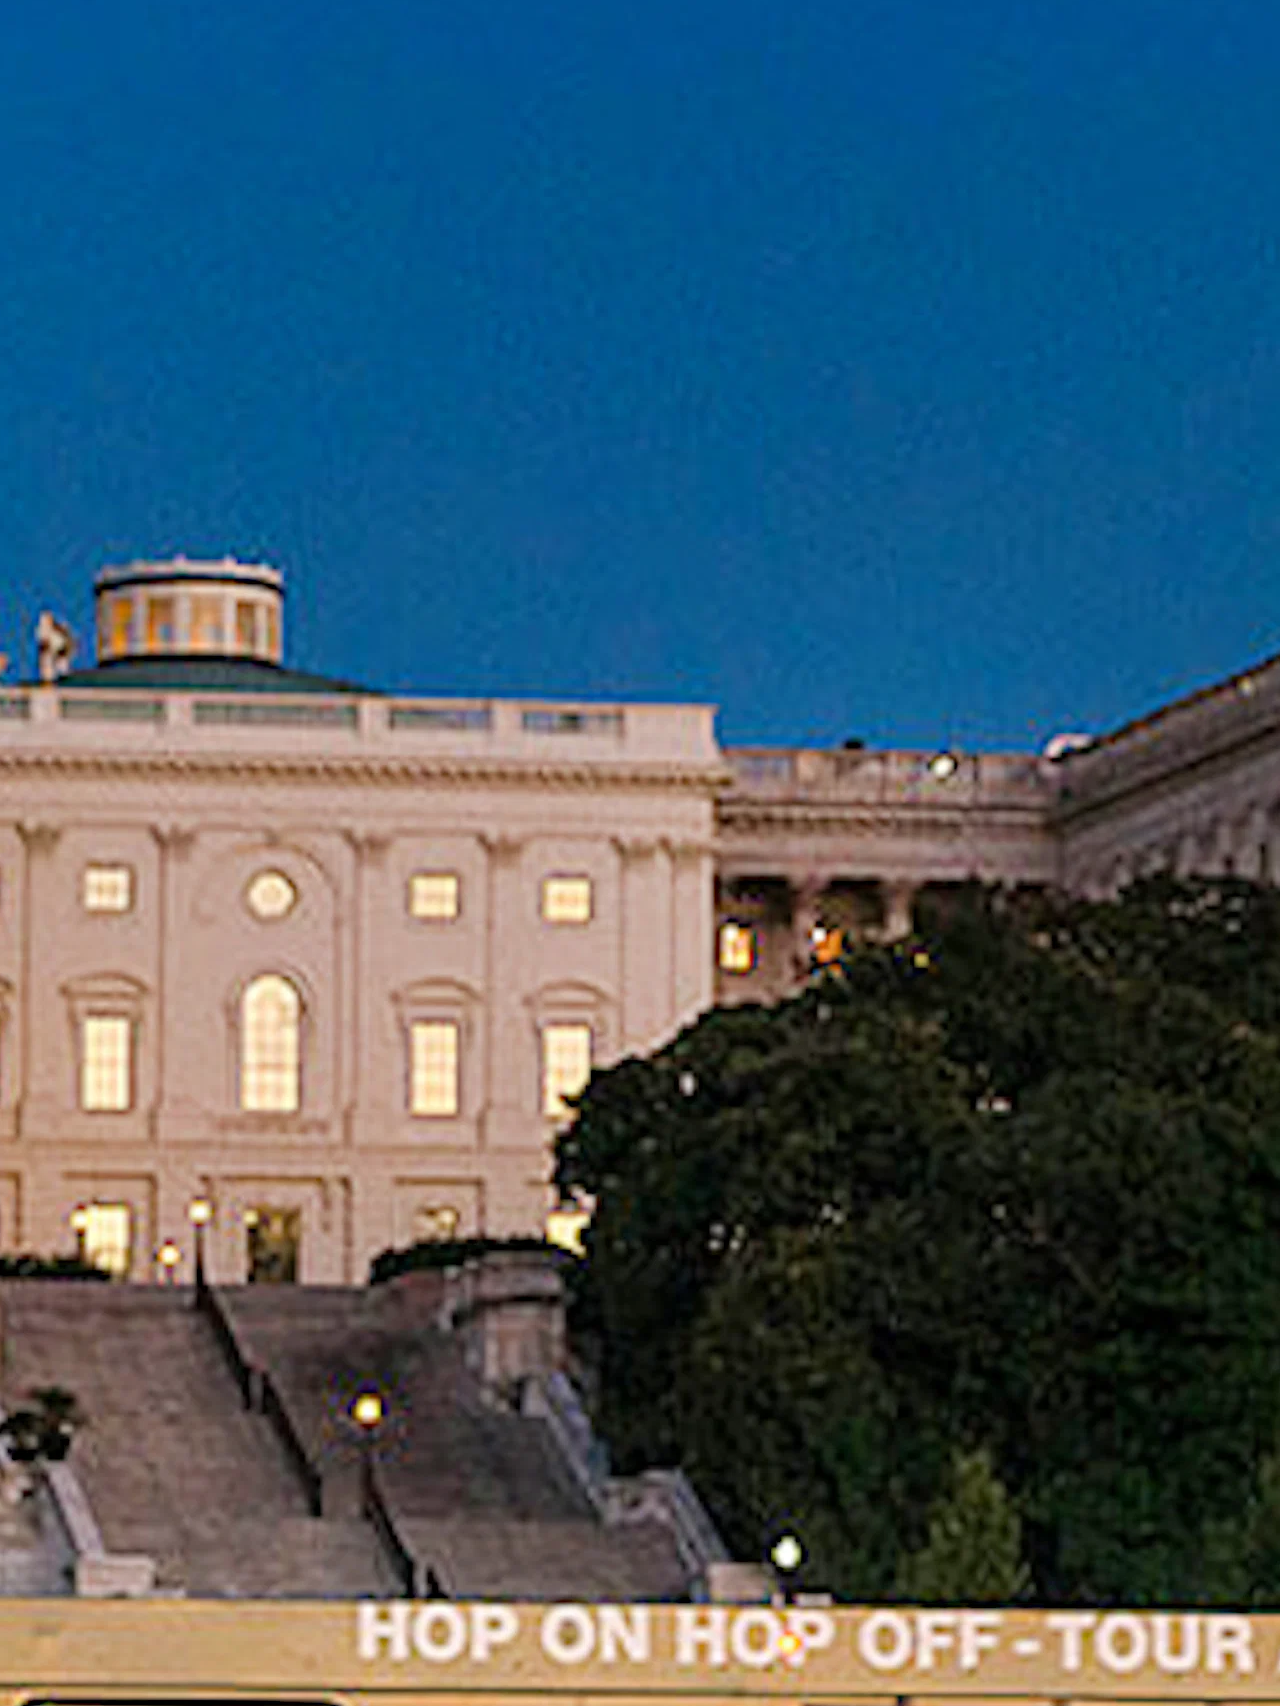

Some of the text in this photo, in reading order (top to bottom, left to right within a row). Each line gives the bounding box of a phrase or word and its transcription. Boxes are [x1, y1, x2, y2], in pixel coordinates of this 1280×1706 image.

[356, 1599, 520, 1663] HOP
[540, 1601, 651, 1664] ON
[674, 1606, 837, 1669] HOP
